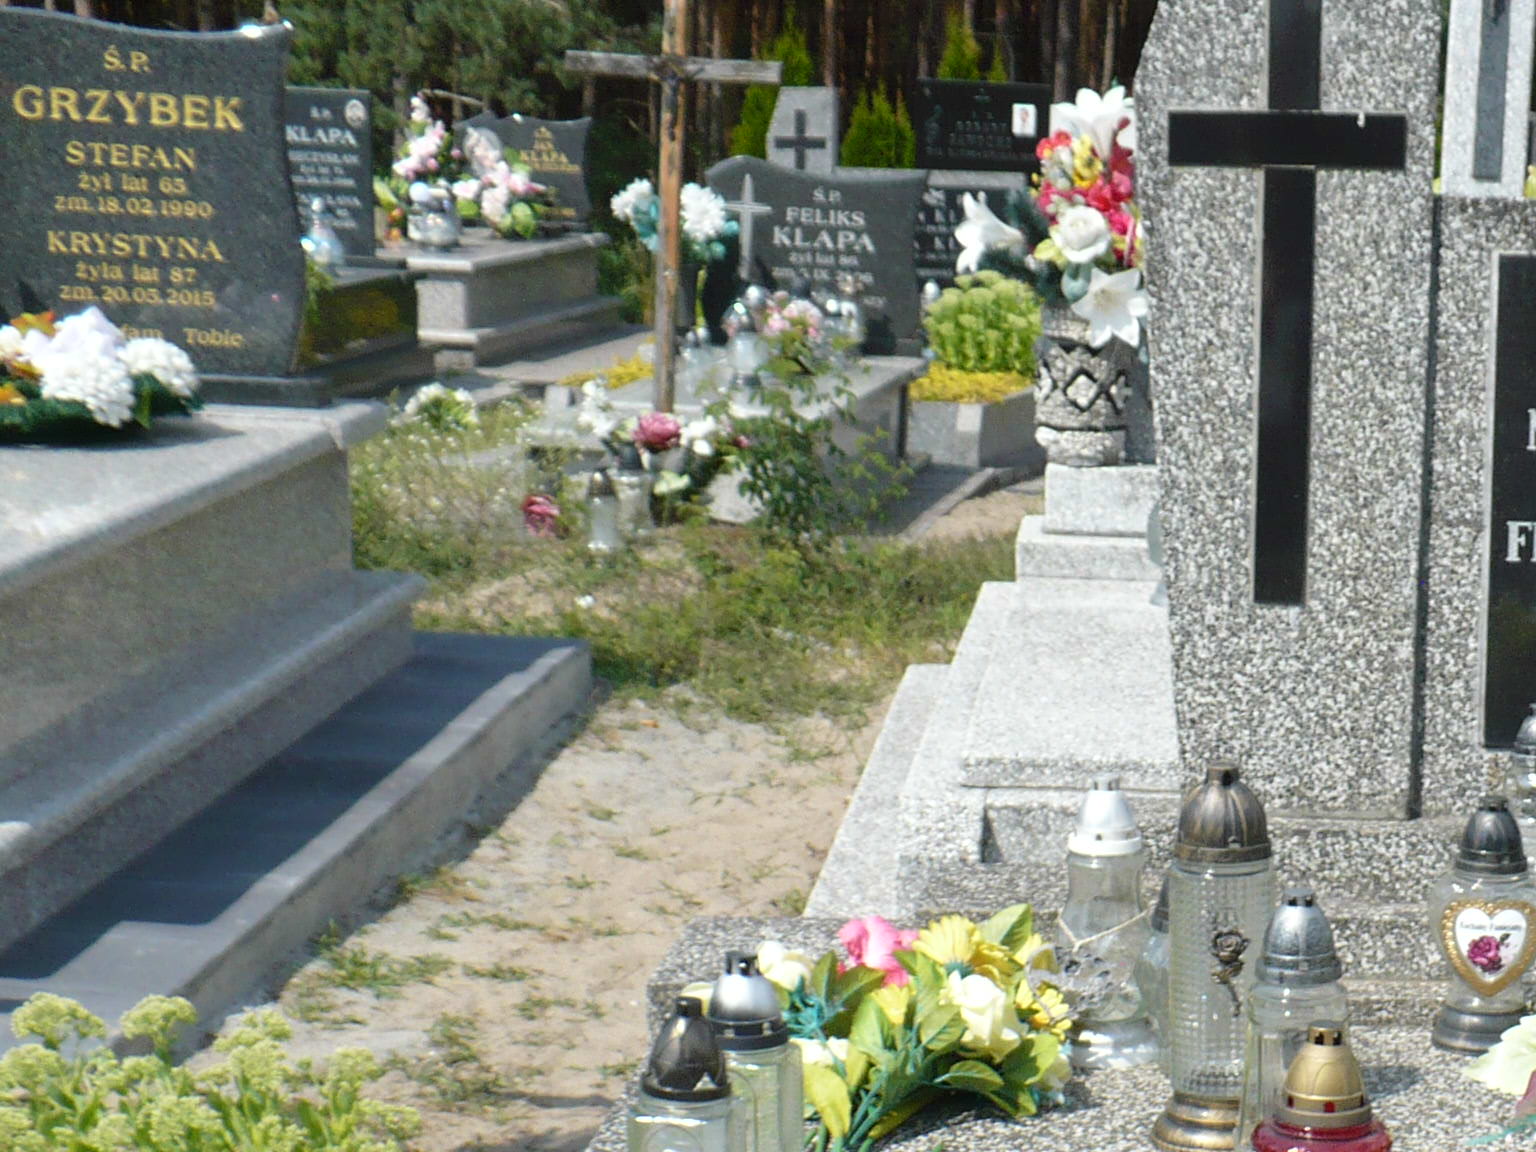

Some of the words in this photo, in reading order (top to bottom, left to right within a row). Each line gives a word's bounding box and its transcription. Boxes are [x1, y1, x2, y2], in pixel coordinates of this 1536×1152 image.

[12, 84, 244, 131] GRZYBEK
[65, 140, 196, 171] STEFAN
[122, 173, 149, 193] lat
[786, 206, 865, 228] FELIKS
[47, 230, 226, 262] KRYSTYNA
[772, 225, 876, 254] KLAPA
[133, 263, 160, 282] lat
